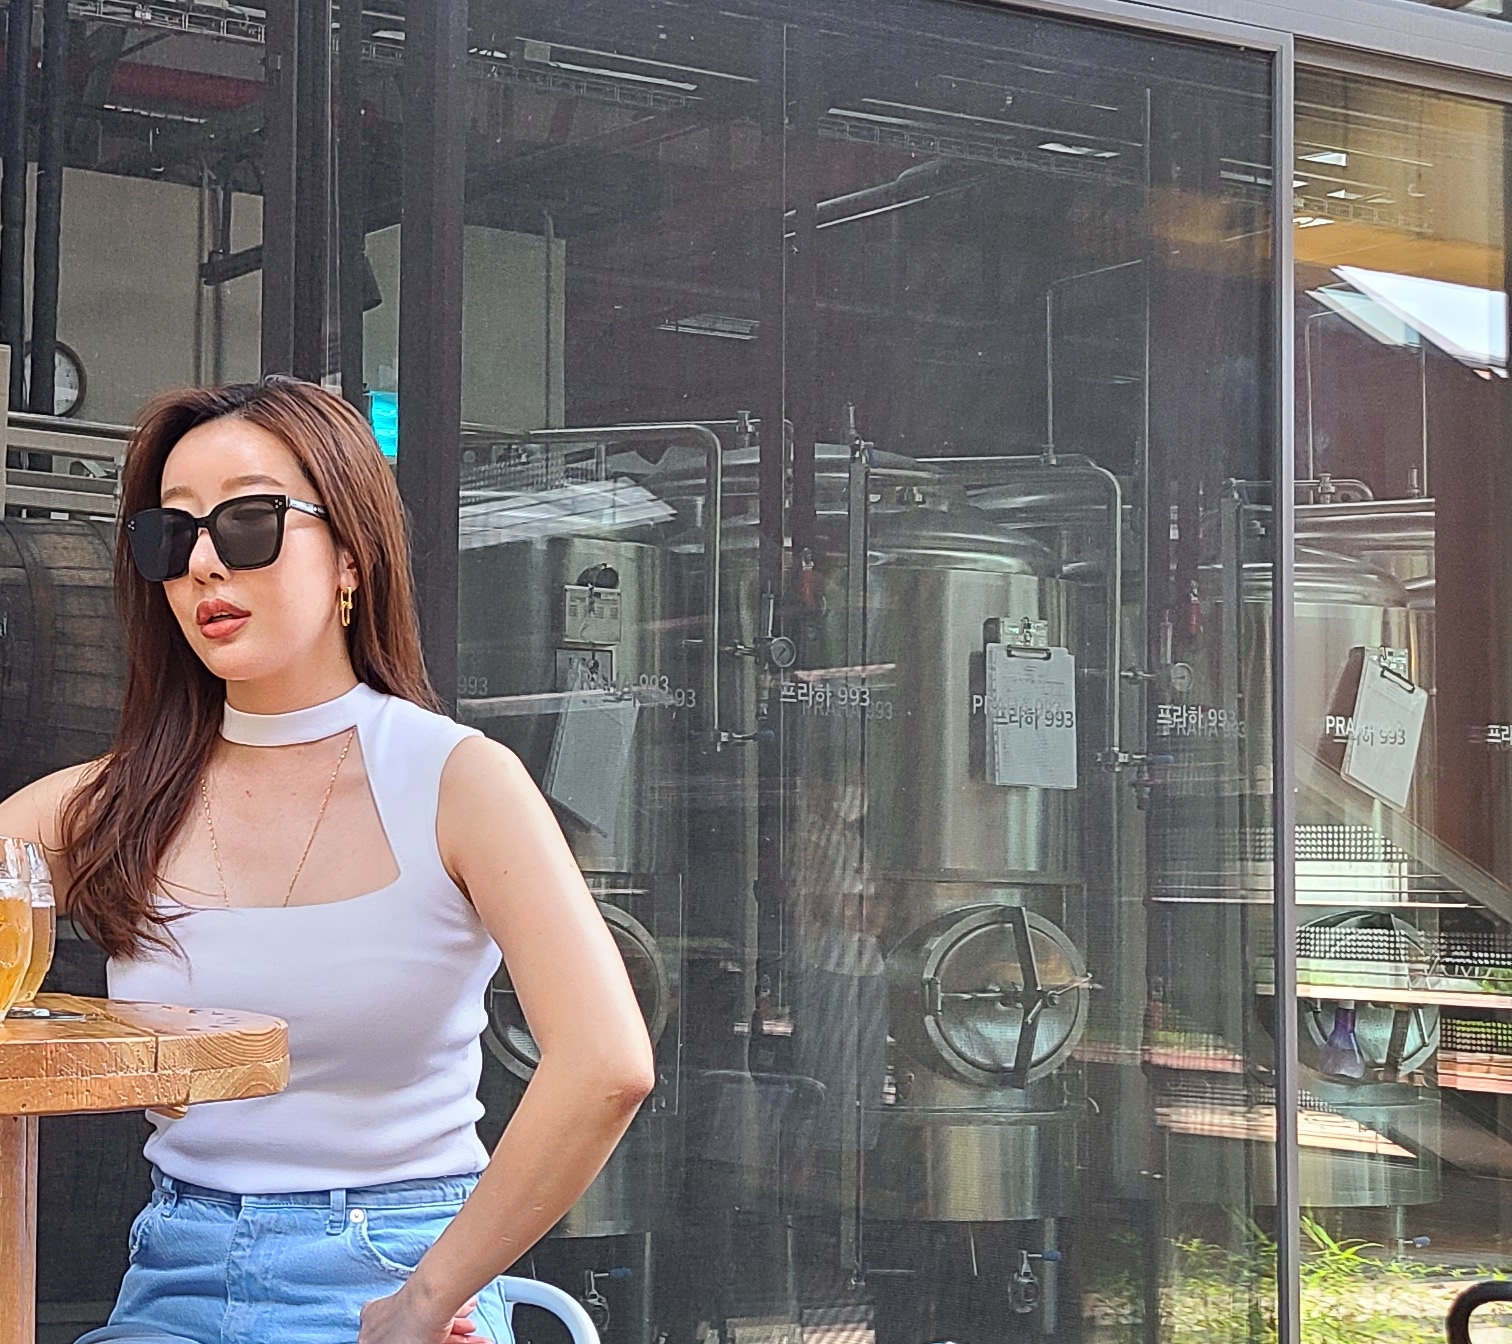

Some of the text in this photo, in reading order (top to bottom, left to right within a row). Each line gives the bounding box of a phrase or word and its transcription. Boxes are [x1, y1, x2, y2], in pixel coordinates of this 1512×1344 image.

[779, 682, 870, 707] 프라하 993
[1045, 711, 1074, 729] 993
[1156, 704, 1203, 729] 프라하
